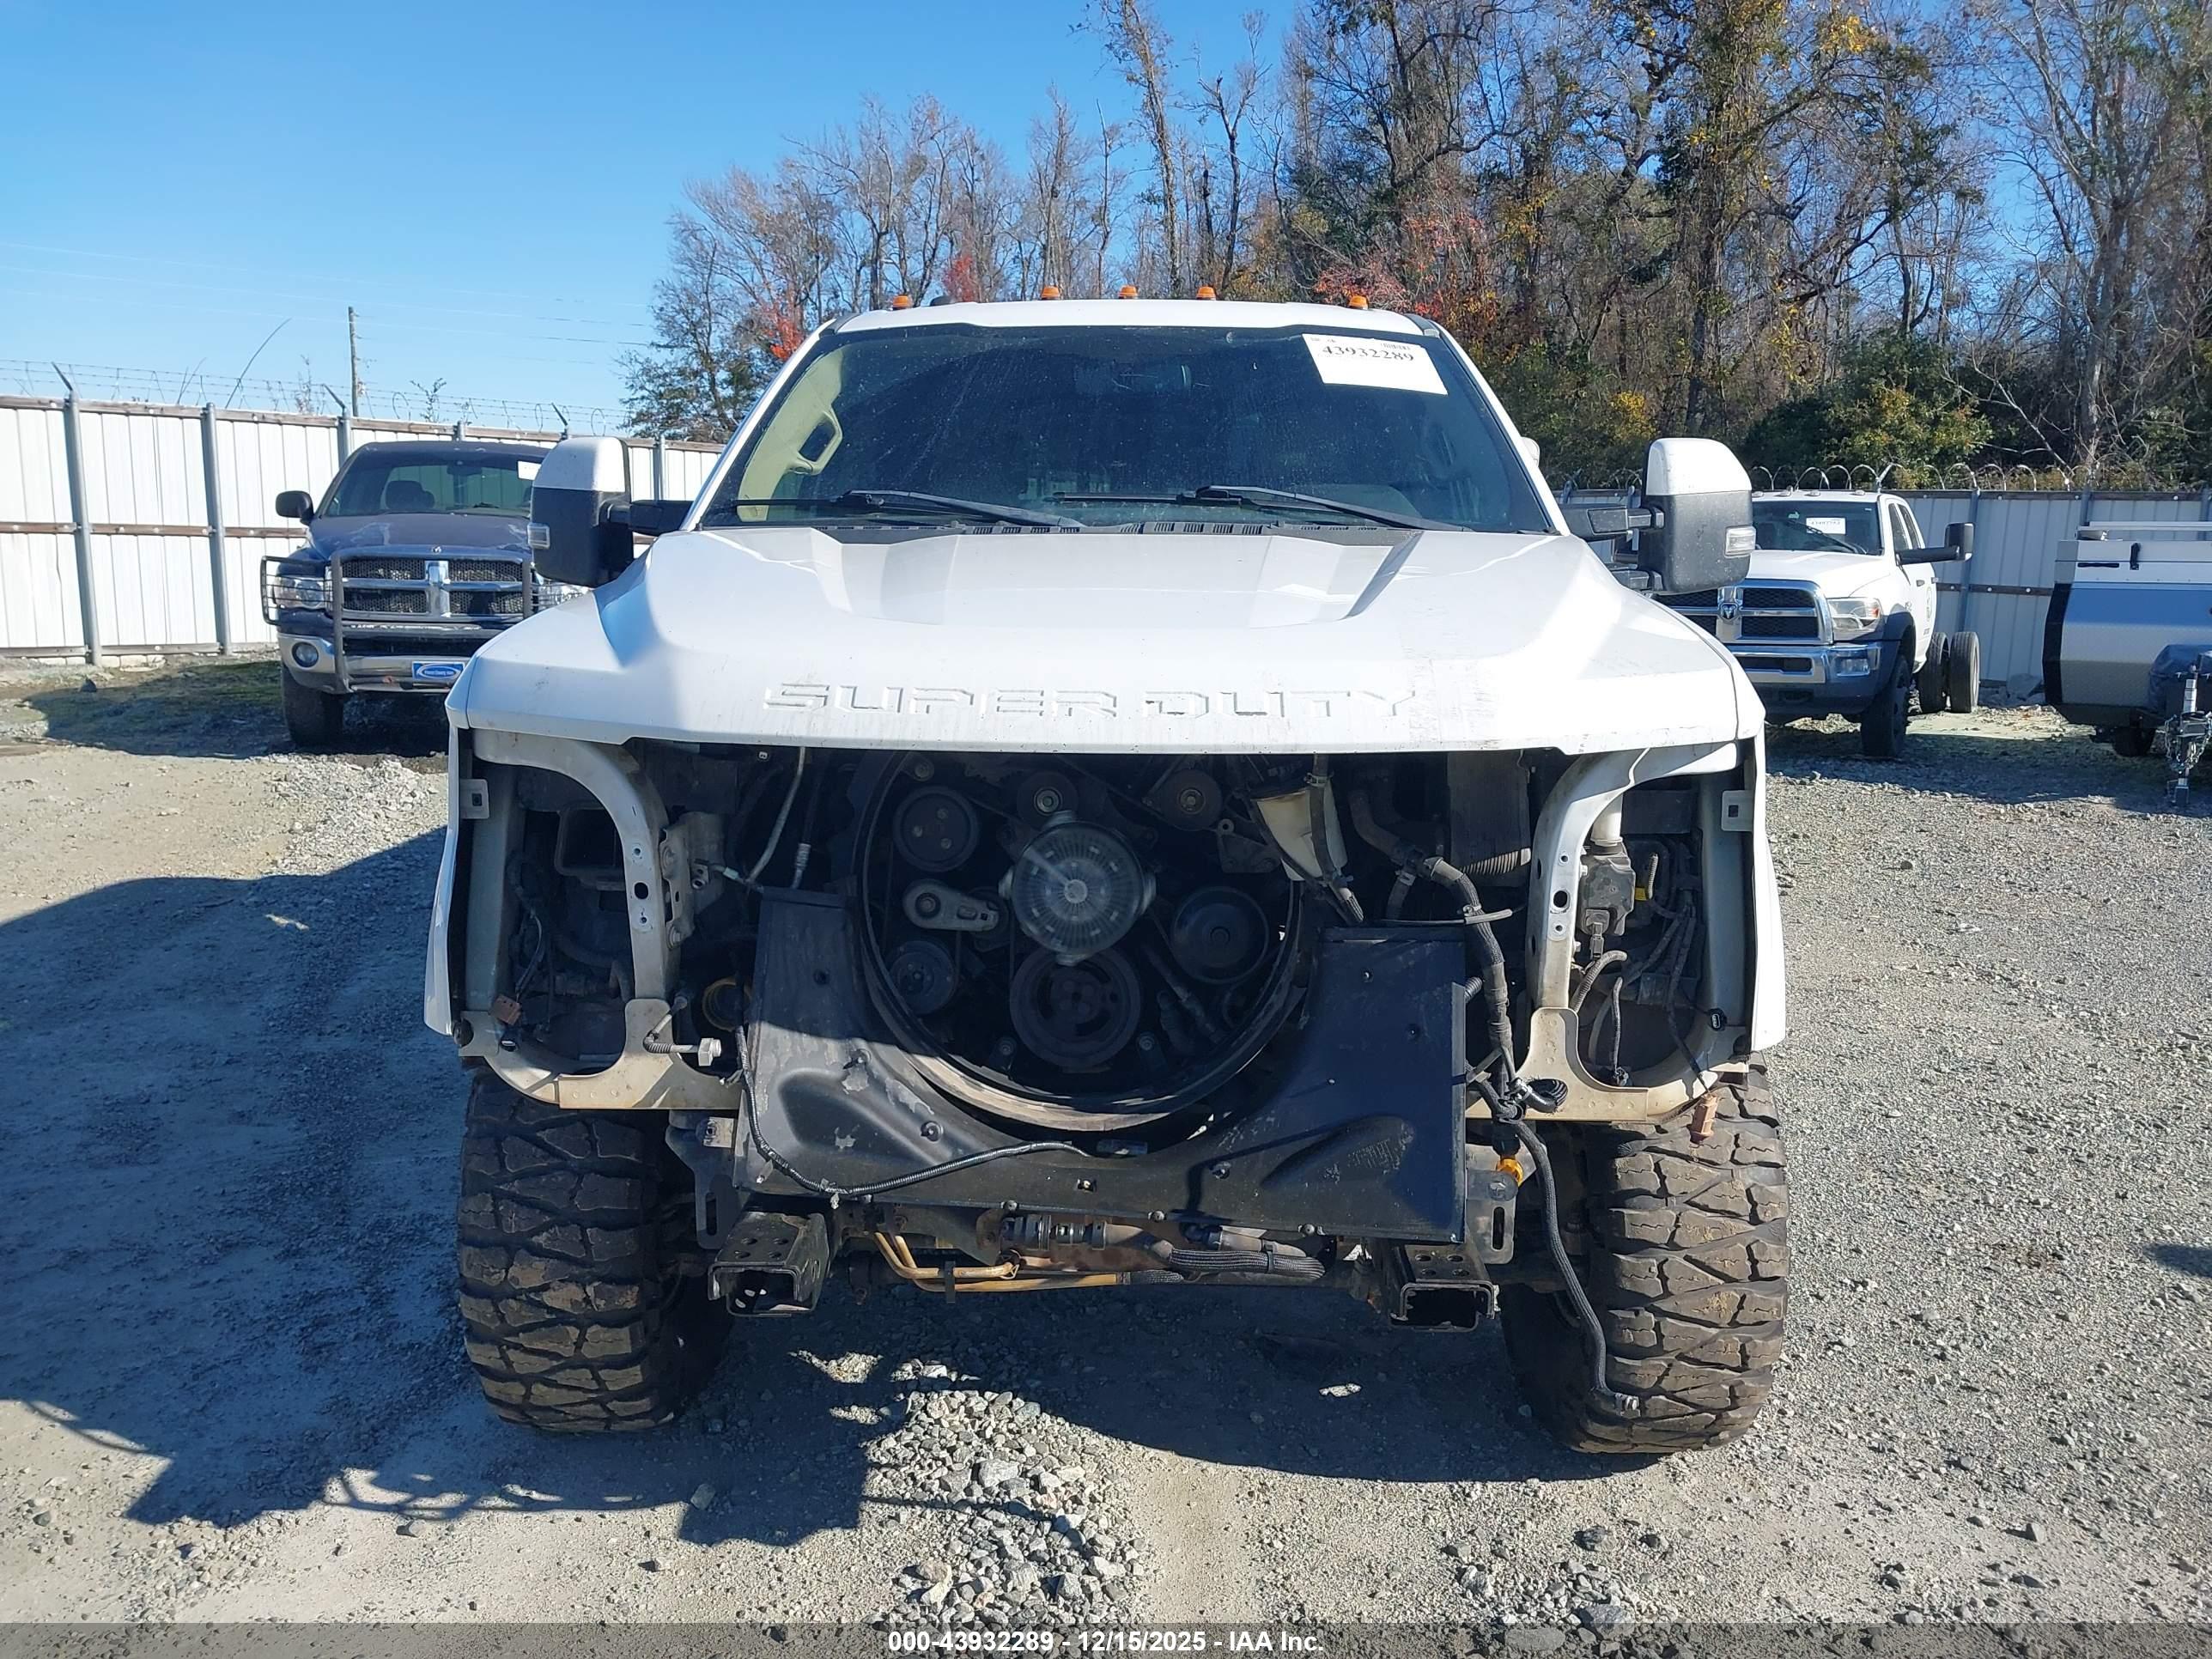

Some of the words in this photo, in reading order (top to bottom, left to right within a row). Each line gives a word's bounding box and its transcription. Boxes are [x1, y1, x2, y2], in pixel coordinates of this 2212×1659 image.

[1322, 345, 1414, 362] 43932289
[763, 683, 1116, 717] SUPER
[1145, 690, 1416, 719] DUTY
